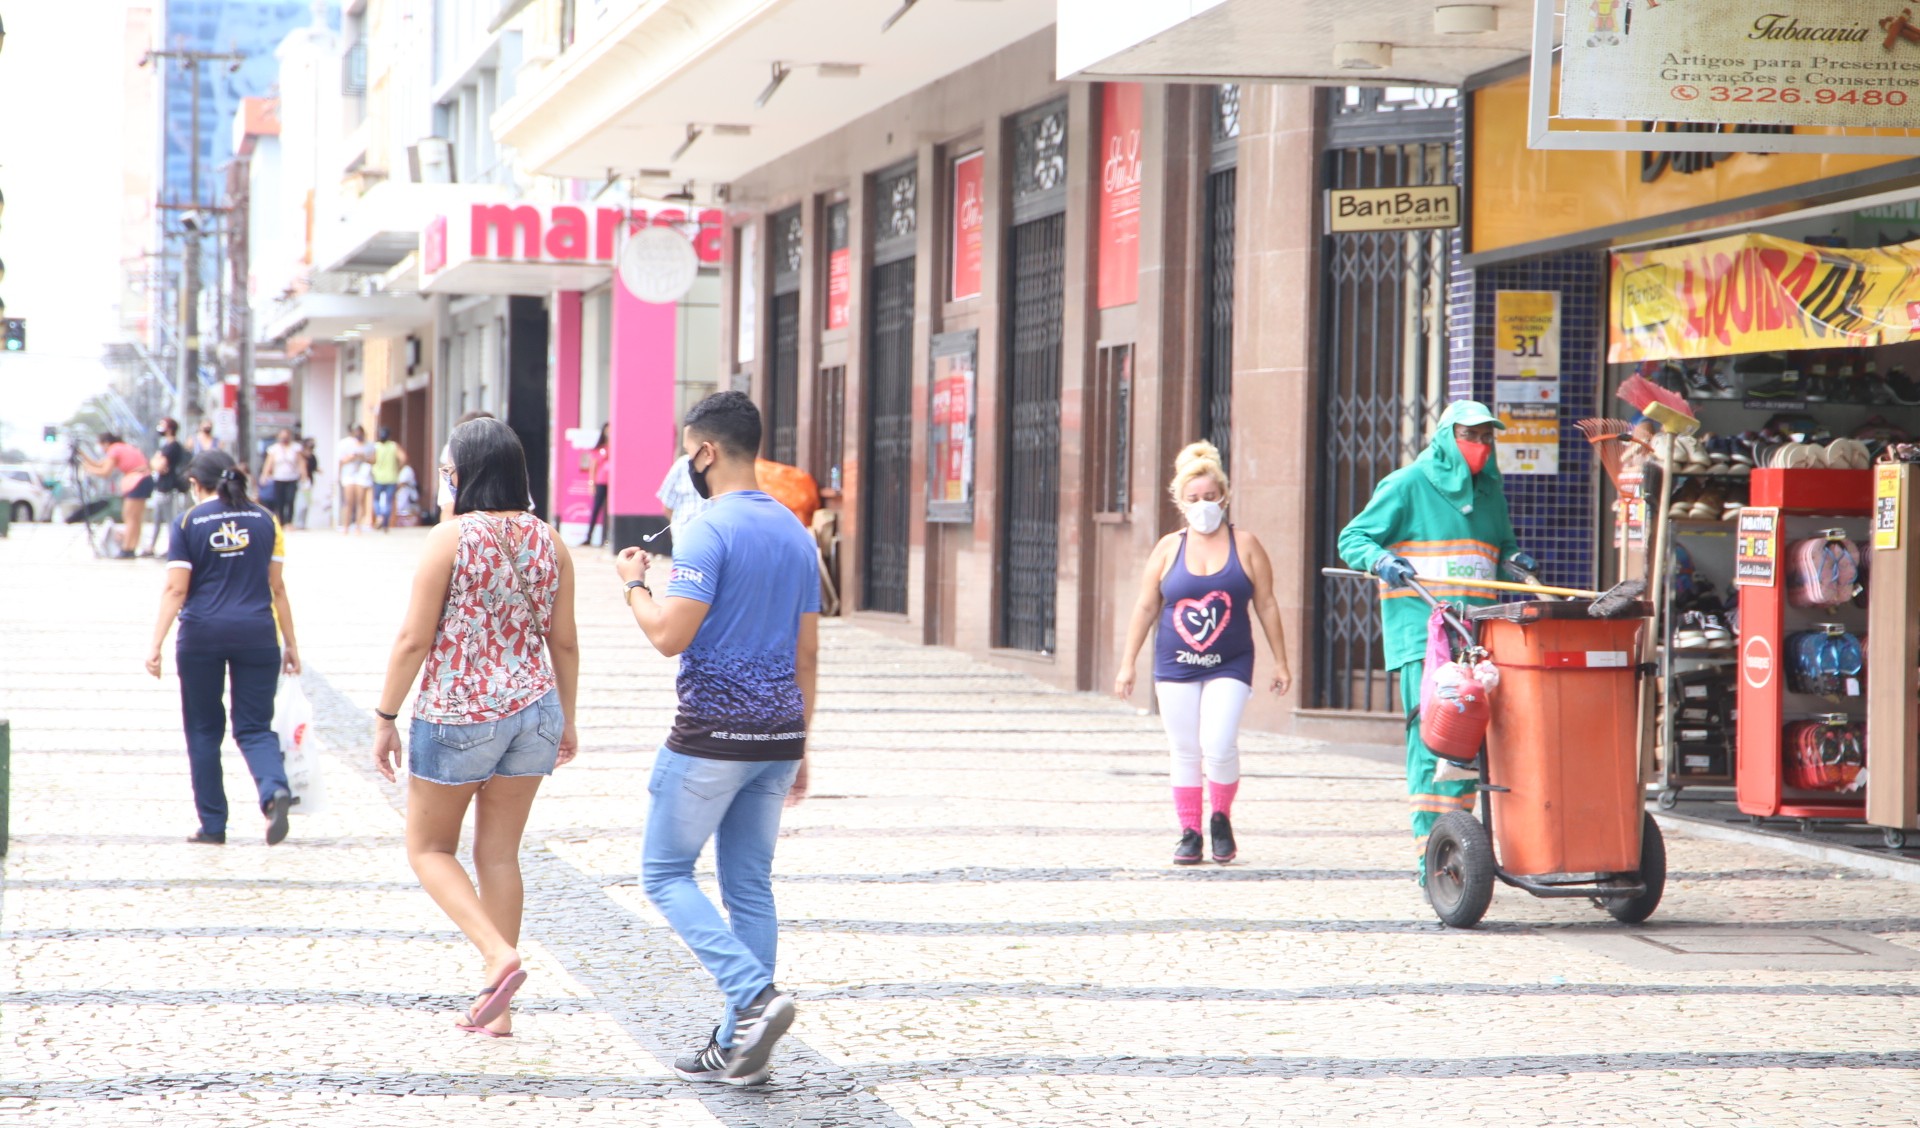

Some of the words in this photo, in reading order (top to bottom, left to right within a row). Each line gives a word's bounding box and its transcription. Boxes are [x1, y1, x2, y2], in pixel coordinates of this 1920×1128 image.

[1748, 13, 1869, 42] Tabacaria
[1661, 53, 1745, 69] Artigos
[1753, 56, 1802, 70] para
[1811, 57, 1920, 71] Presentes
[1661, 68, 1777, 85] Gravações
[1785, 75, 1797, 84] e
[1805, 73, 1920, 87] Consertos
[1709, 86, 1908, 106] 3226.9480
[1339, 192, 1449, 217] BanBan
[1383, 214, 1451, 224] calçados
[1512, 335, 1543, 357] 31
[1175, 650, 1222, 668] ZUMBA
[729, 733, 752, 741] AQUI
[752, 733, 770, 741] NOS
